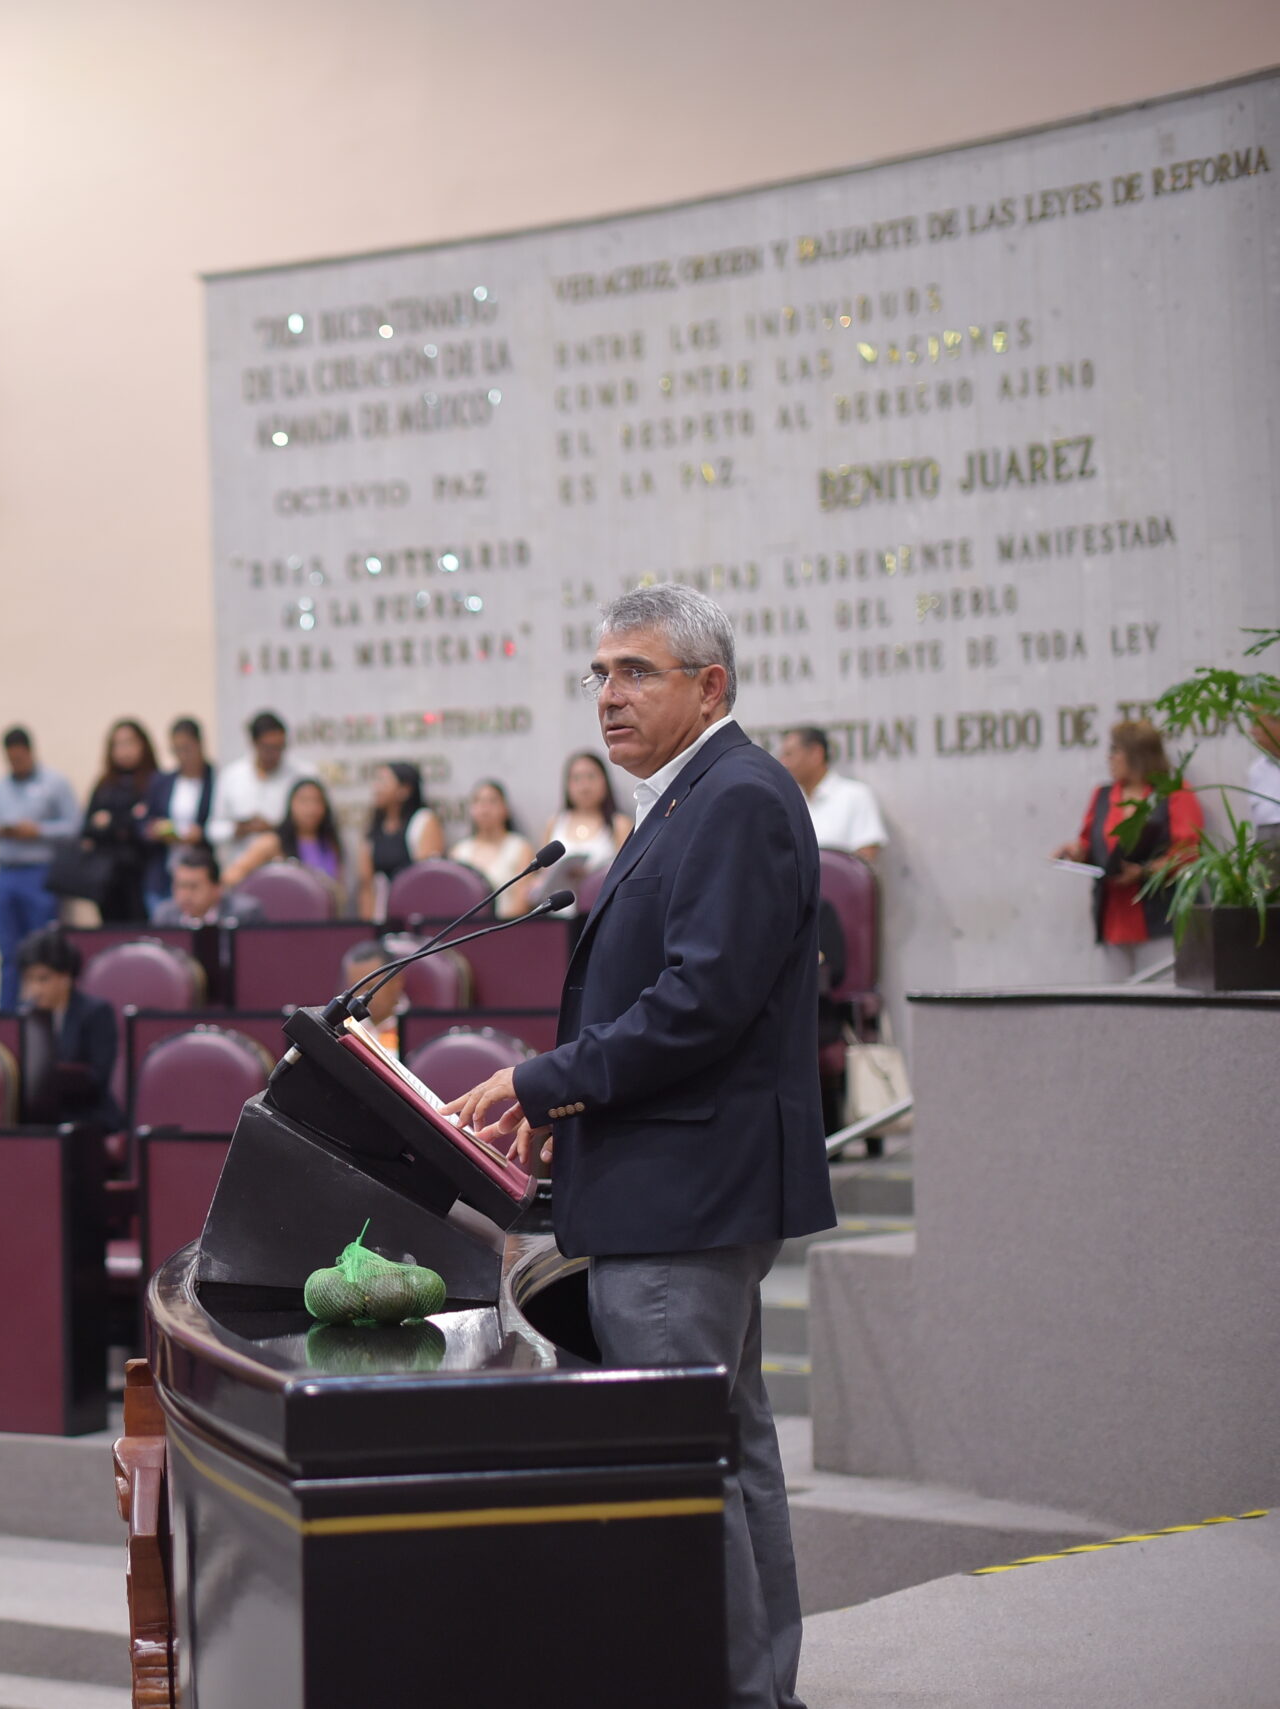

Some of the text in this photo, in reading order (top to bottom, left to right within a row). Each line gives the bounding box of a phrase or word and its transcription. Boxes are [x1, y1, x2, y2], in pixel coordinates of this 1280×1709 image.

[928, 210, 957, 240] DE
[969, 199, 1015, 233] LAS
[1025, 183, 1102, 224] LEYES
[1112, 174, 1142, 206] DE
[1152, 148, 1270, 195] REFORMA
[961, 436, 1096, 493] JUAREZ
[997, 516, 1176, 562] MANIFESTADA
[1111, 623, 1159, 656] LEY
[934, 706, 1041, 756] LERDO
[1060, 704, 1097, 748] DE
